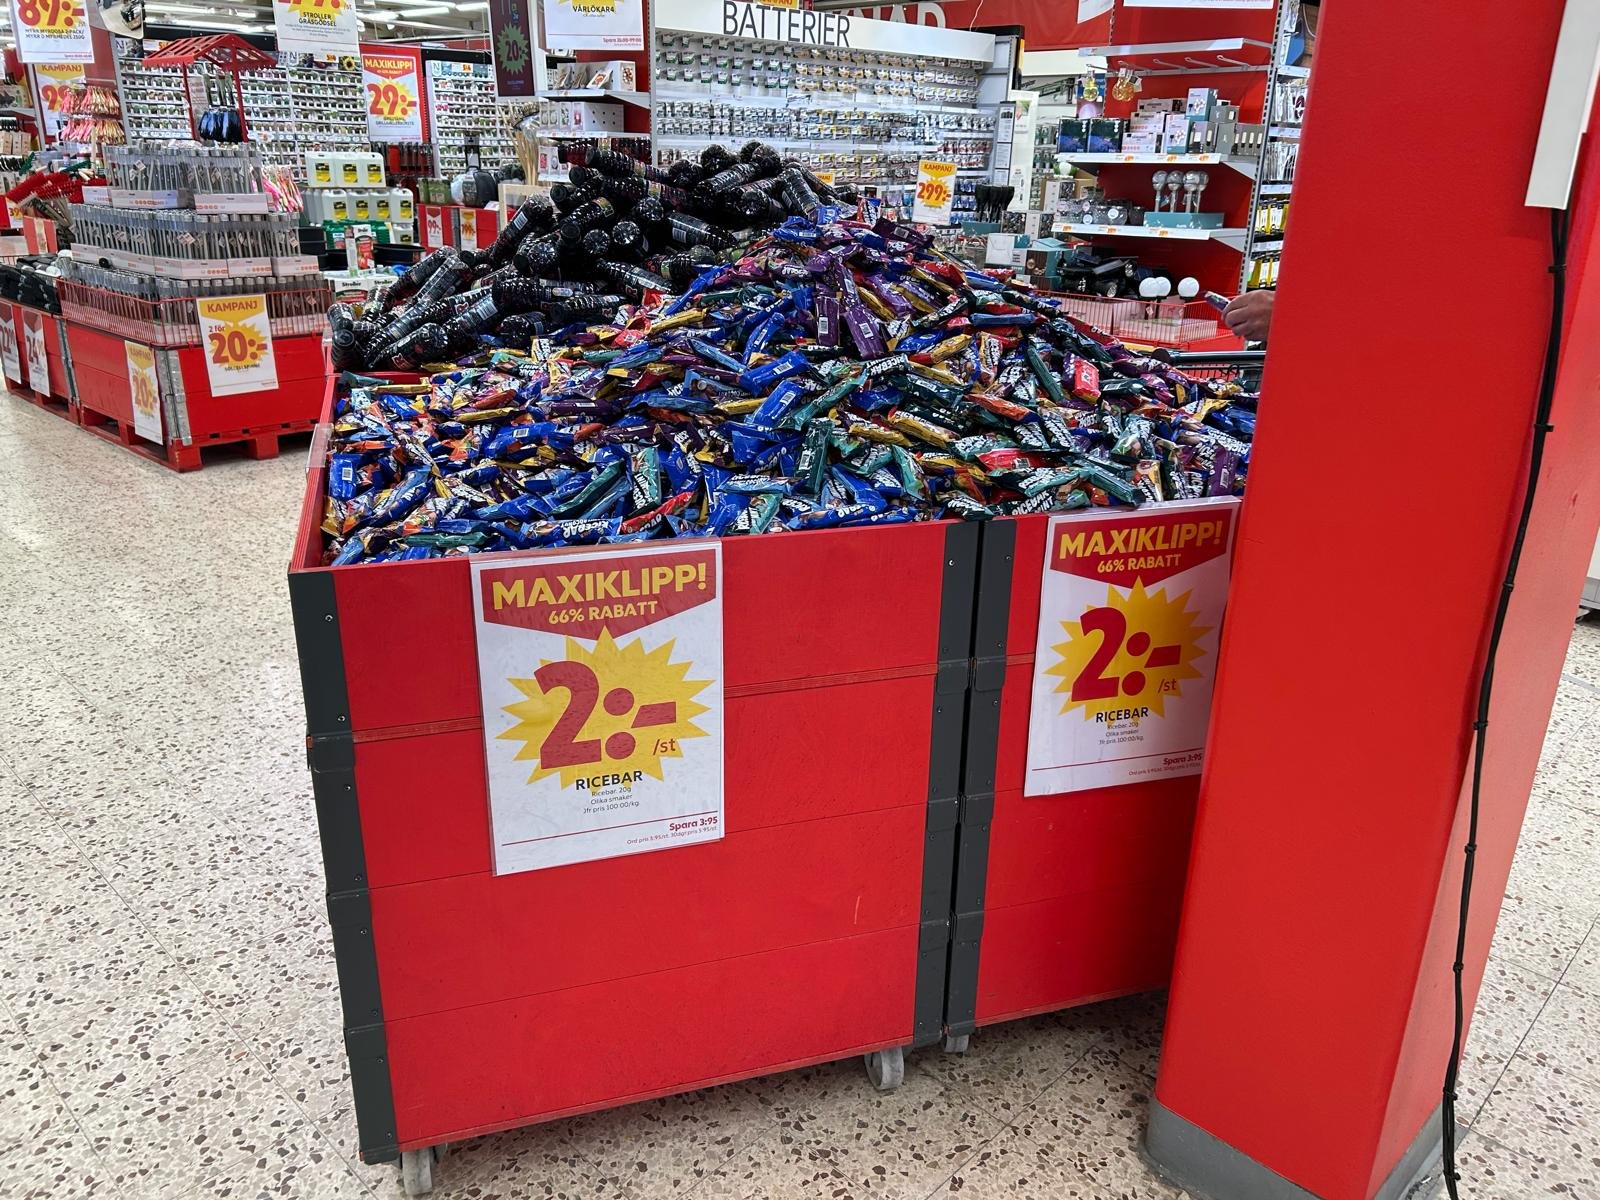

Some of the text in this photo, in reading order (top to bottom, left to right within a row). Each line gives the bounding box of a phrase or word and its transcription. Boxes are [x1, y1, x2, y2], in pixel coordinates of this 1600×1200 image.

[303, 12, 332, 20] STROLLER
[723, 1, 850, 48] BATTERIER
[364, 59, 413, 70] MAXIKLIPP!
[367, 84, 417, 116] 29:-
[917, 182, 952, 202] 299:-
[207, 301, 258, 313] KAMPANJ
[208, 330, 268, 364] 20:-
[563, 520, 609, 539] RICEBAR
[1059, 520, 1223, 560] MAXIKLIPP!
[1097, 554, 1181, 574] 66% RABATT
[492, 563, 707, 610] MAXIKLIPP!
[548, 600, 658, 625] 66% RABATT
[1071, 607, 1181, 703] 2:-
[1157, 678, 1177, 694] /st
[533, 660, 677, 770] 2:-
[1096, 706, 1149, 723] RICEBAR
[652, 737, 677, 756] /st
[1162, 752, 1202, 766] Spara 3:95
[575, 770, 643, 791] RICEBAR
[608, 794, 633, 802] smaker
[619, 786, 632, 795] 20g
[592, 806, 605, 814] pris
[669, 816, 718, 832] Spara 3:95
